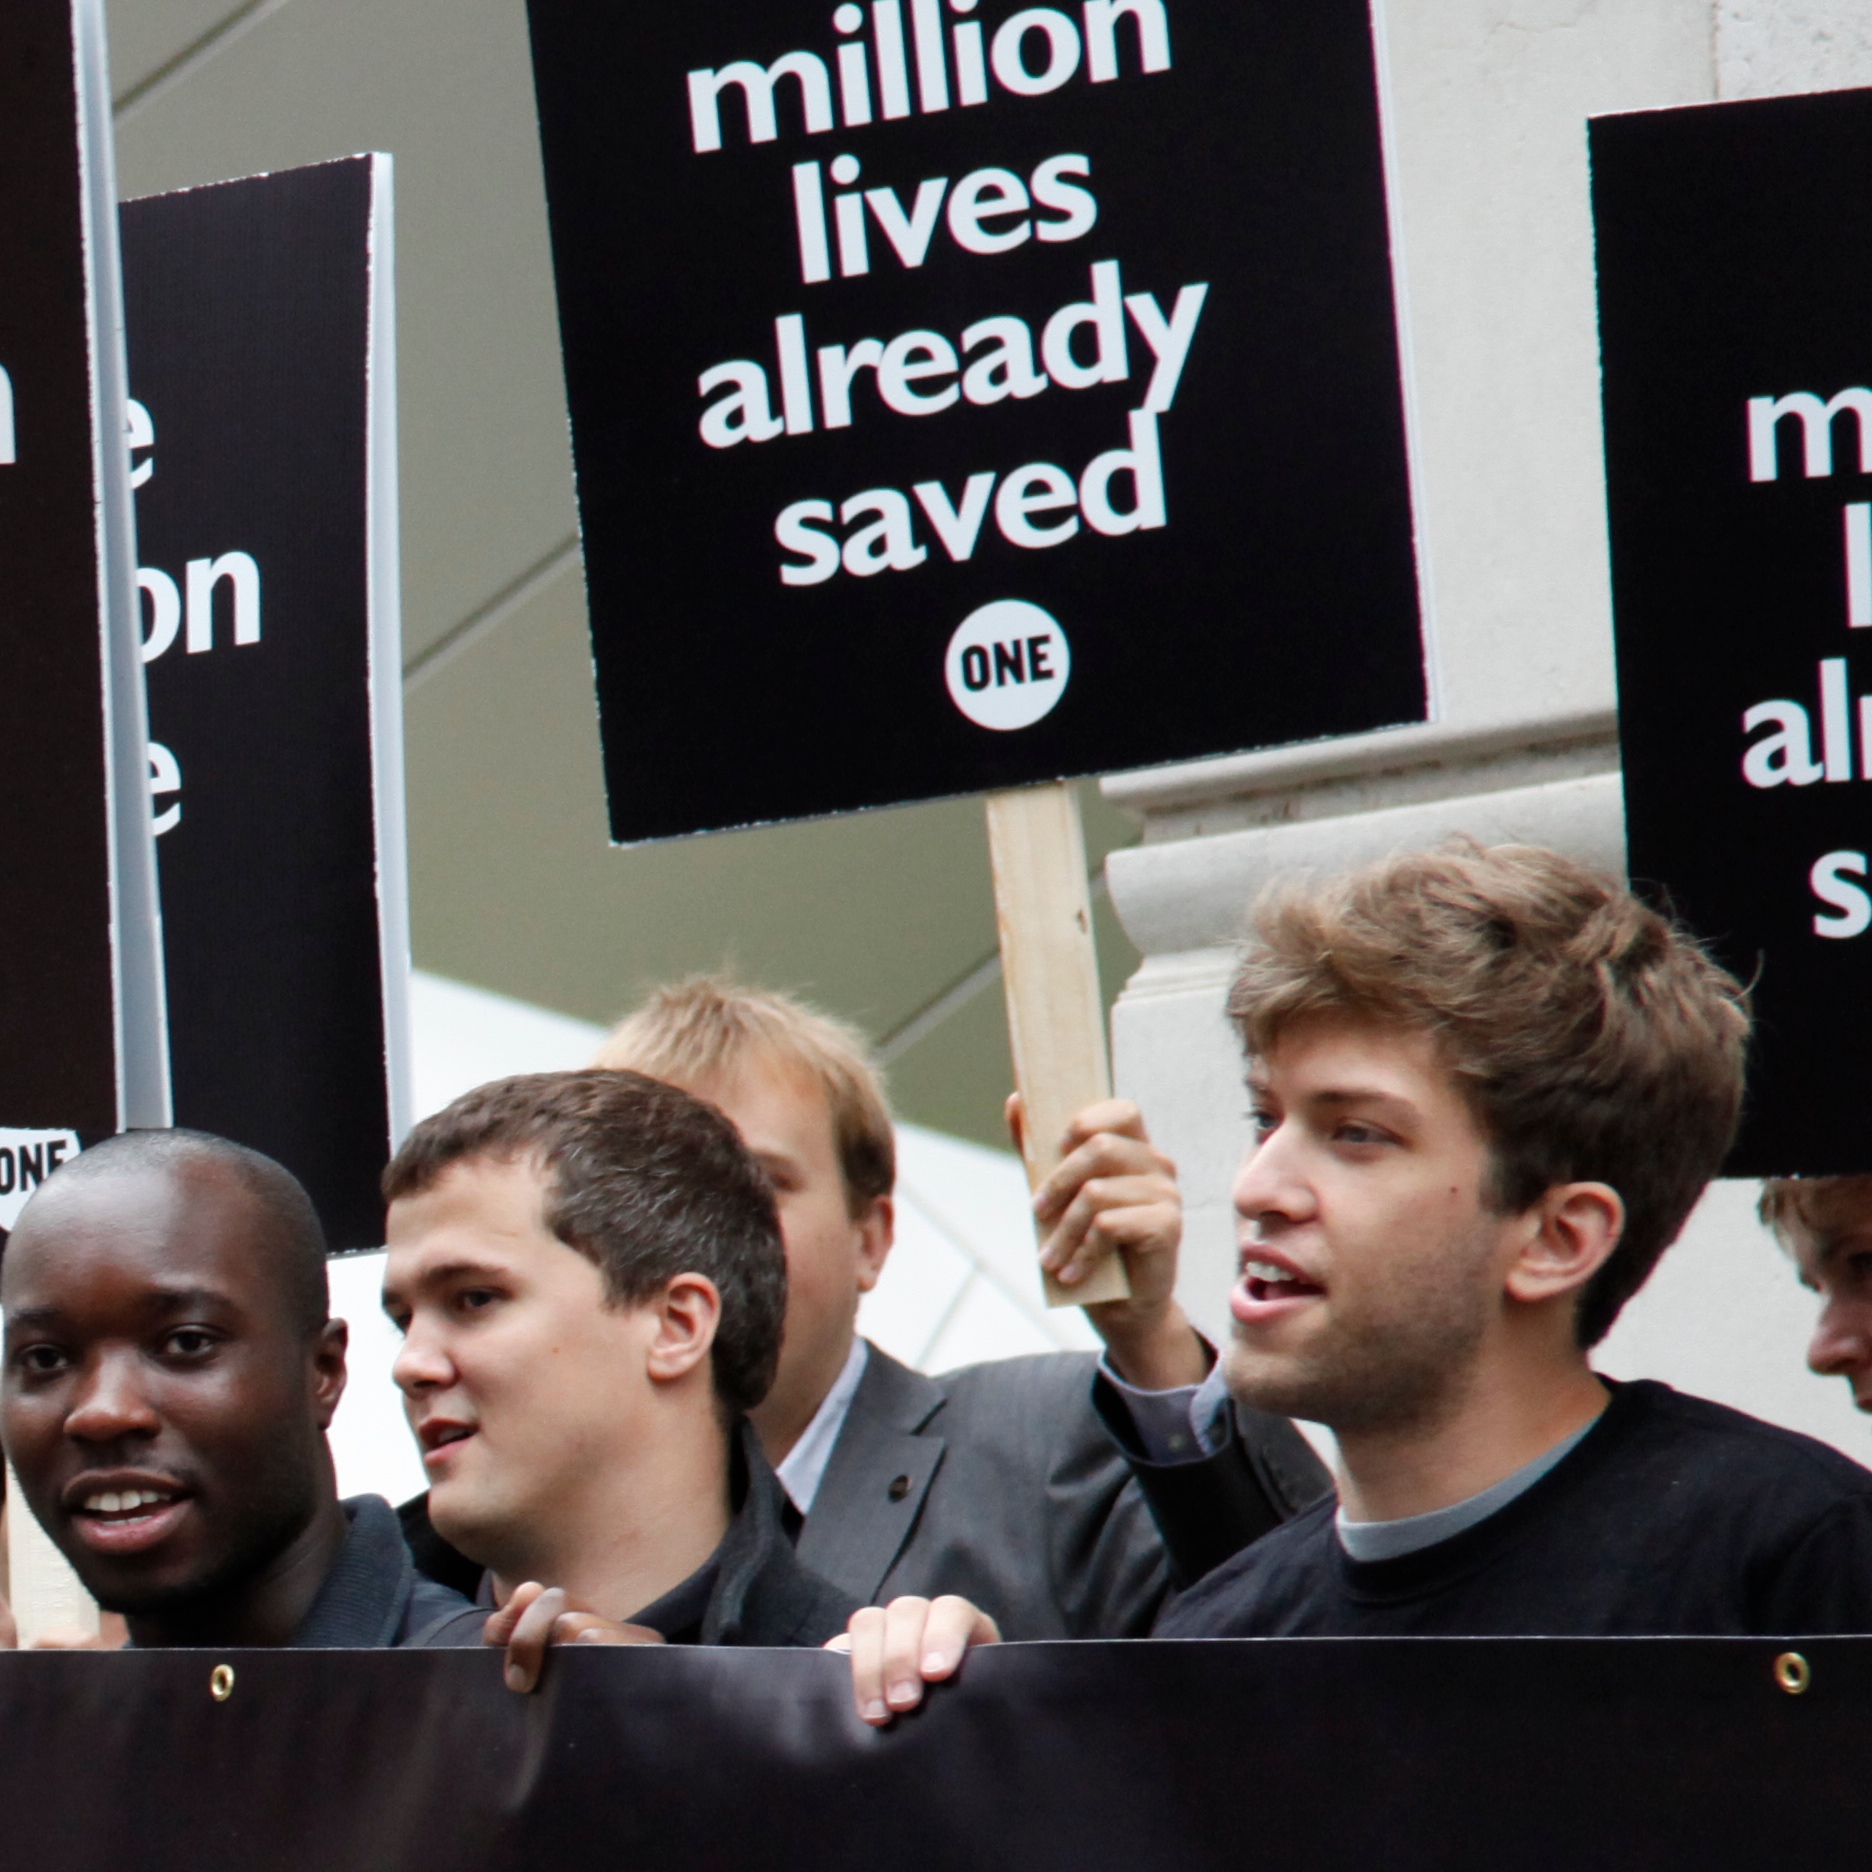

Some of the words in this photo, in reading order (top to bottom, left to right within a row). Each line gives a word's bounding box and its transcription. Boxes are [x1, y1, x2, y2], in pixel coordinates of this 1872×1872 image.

[687, 0, 1171, 153] million
[793, 153, 1097, 283] lives
[699, 259, 1207, 448] already
[776, 406, 1171, 585] saved
[962, 634, 1055, 692] ONE
